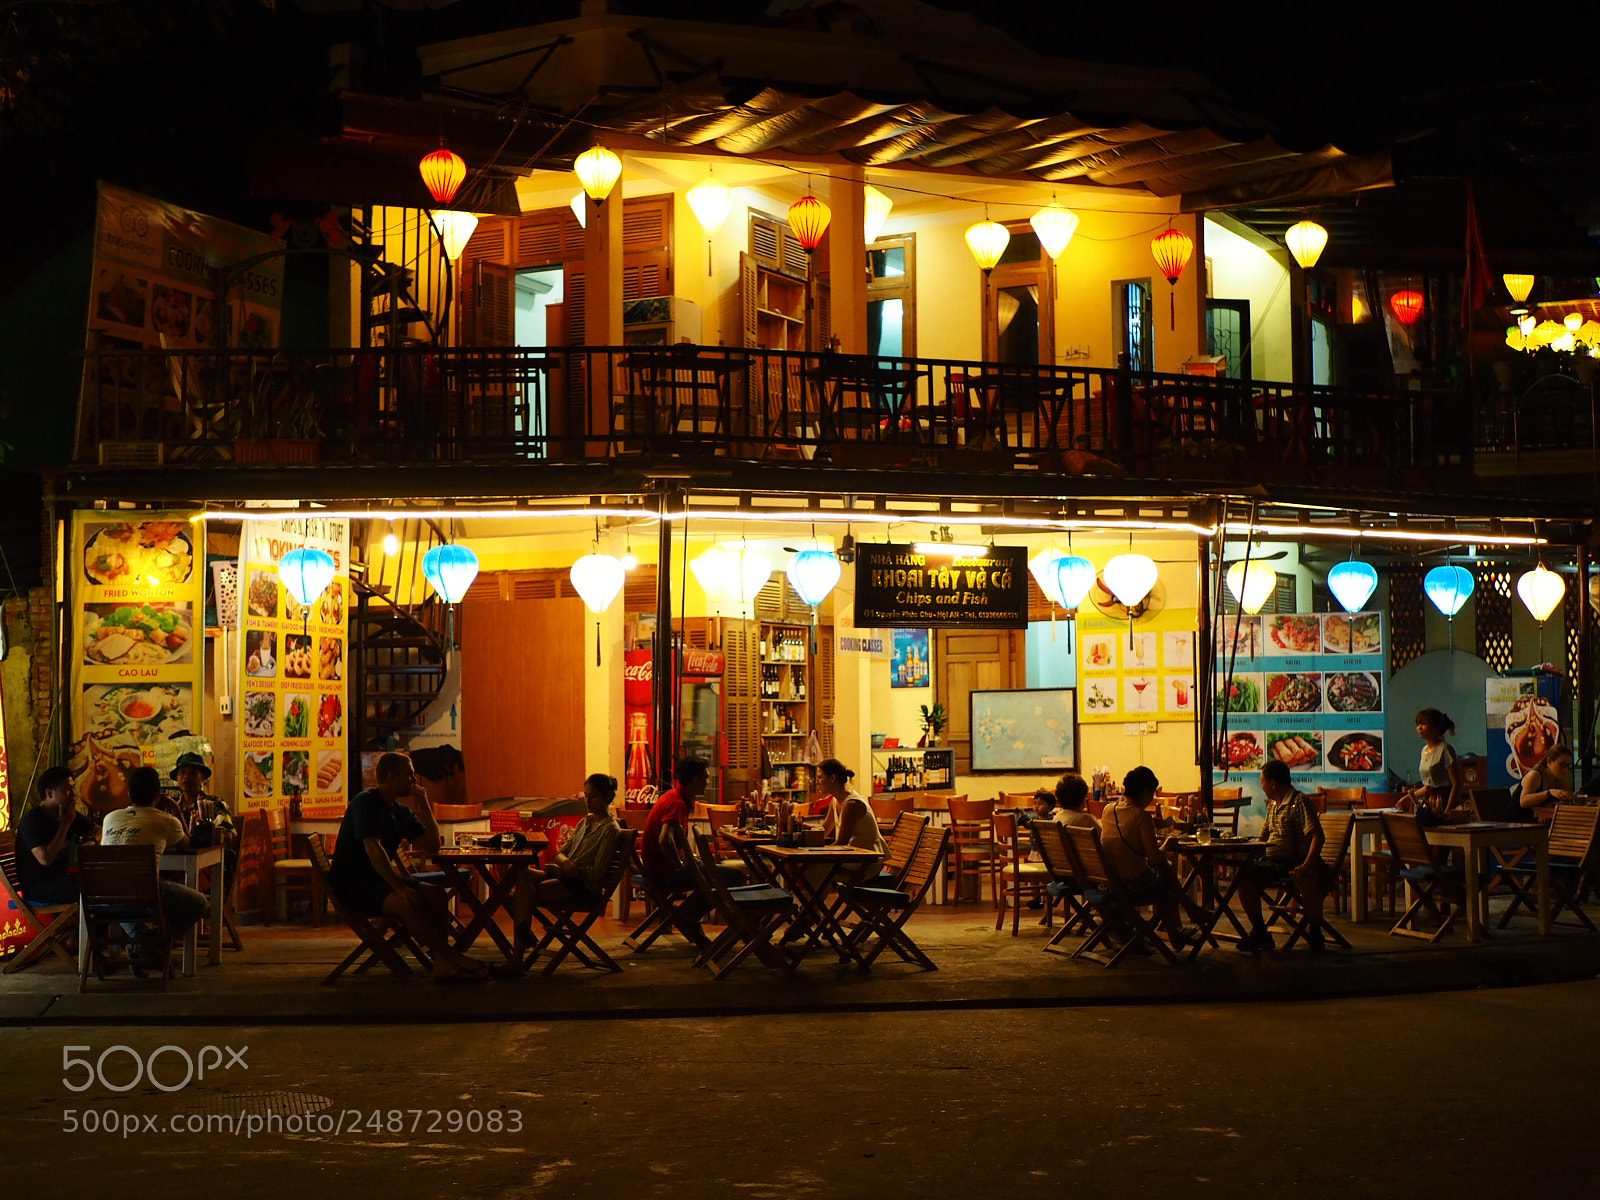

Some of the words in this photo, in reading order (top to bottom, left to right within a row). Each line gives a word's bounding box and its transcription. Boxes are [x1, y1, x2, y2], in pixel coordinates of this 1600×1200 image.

[167, 247, 219, 280] COOKIN
[871, 569, 923, 589] KHOAI
[104, 589, 128, 598] FRIED
[131, 589, 174, 597] WONTON
[896, 591, 932, 607] Chips
[936, 591, 959, 605] and
[962, 592, 989, 605] Fish
[840, 637, 861, 652] COOKING
[861, 638, 883, 653] CLASSES
[687, 651, 719, 673] Coca-Cola
[118, 668, 138, 677] CAO
[141, 668, 158, 677] LAU
[625, 784, 659, 804] ca-Cola
